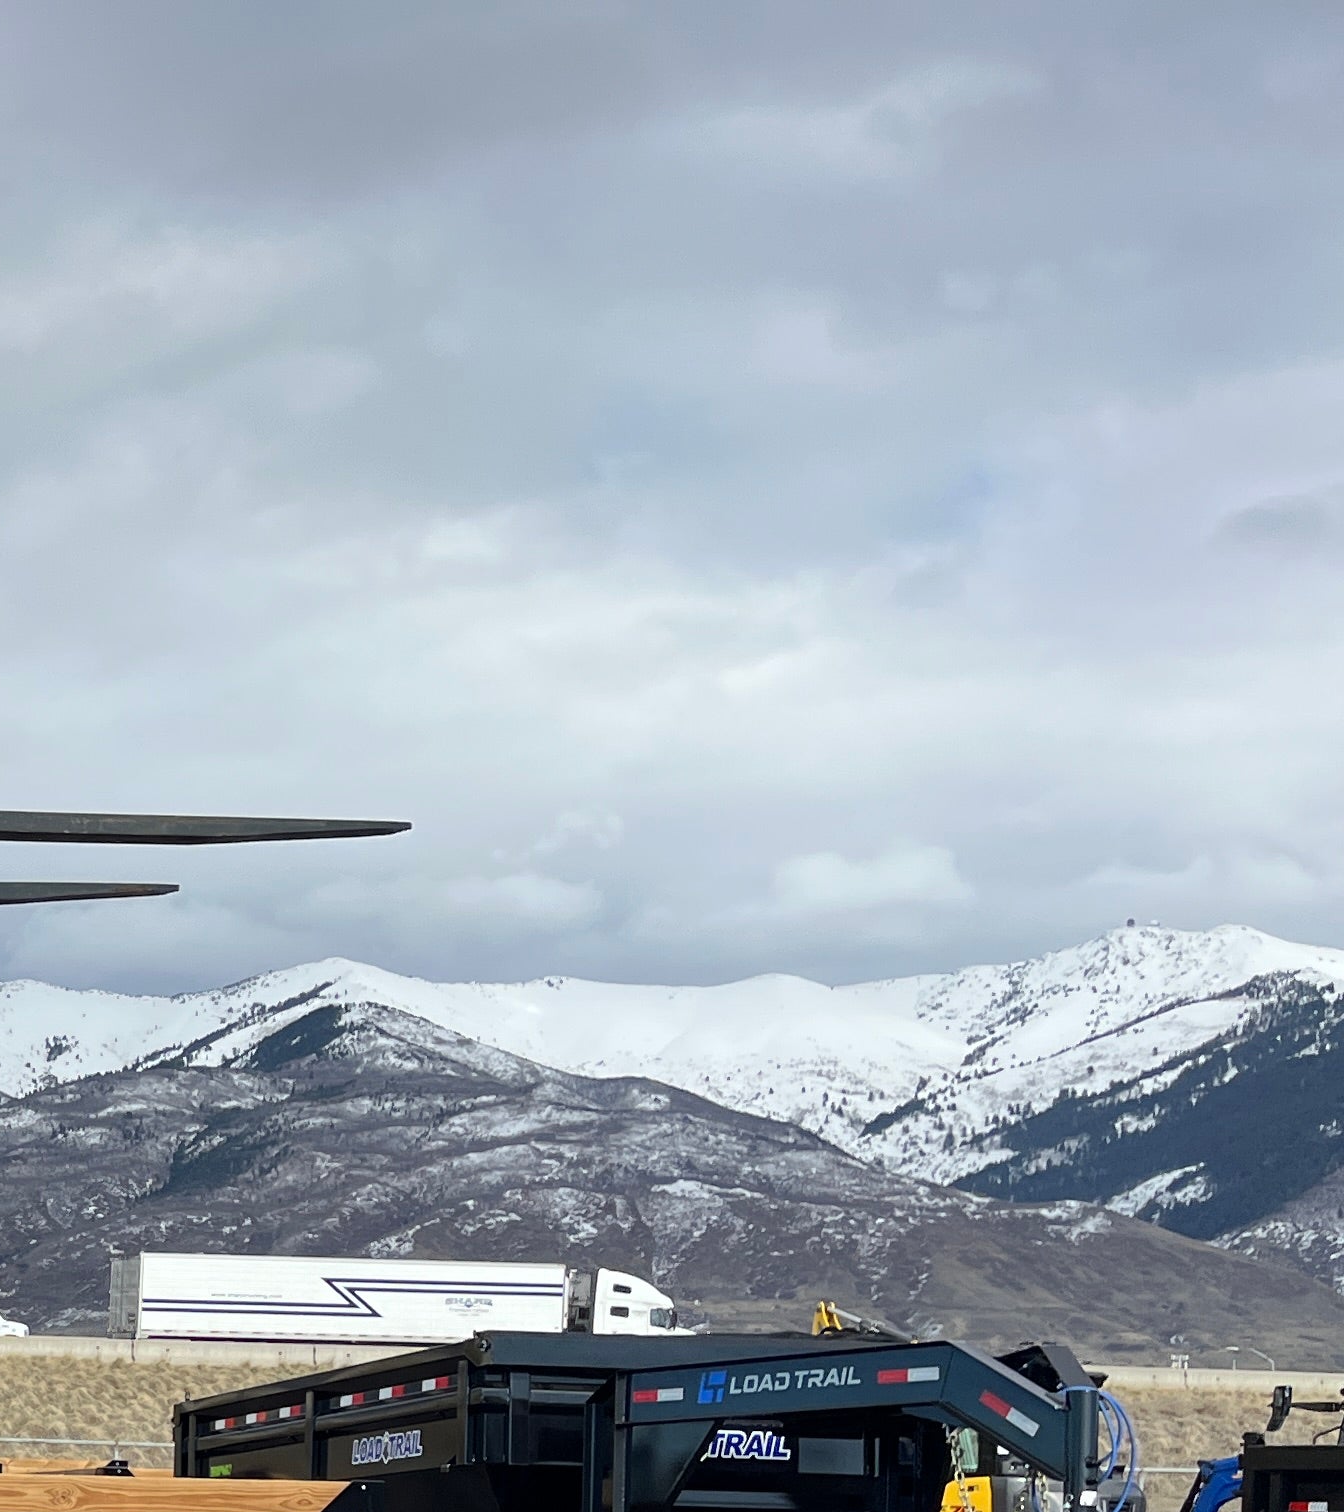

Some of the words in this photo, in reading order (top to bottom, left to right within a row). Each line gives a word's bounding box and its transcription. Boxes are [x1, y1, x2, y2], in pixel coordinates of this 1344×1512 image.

[729, 1372, 790, 1395] LOAD
[794, 1366, 861, 1390] TRAIL
[352, 1436, 383, 1465] LOAD
[388, 1430, 423, 1459] TRAIL
[708, 1429, 791, 1461] TRAIL
